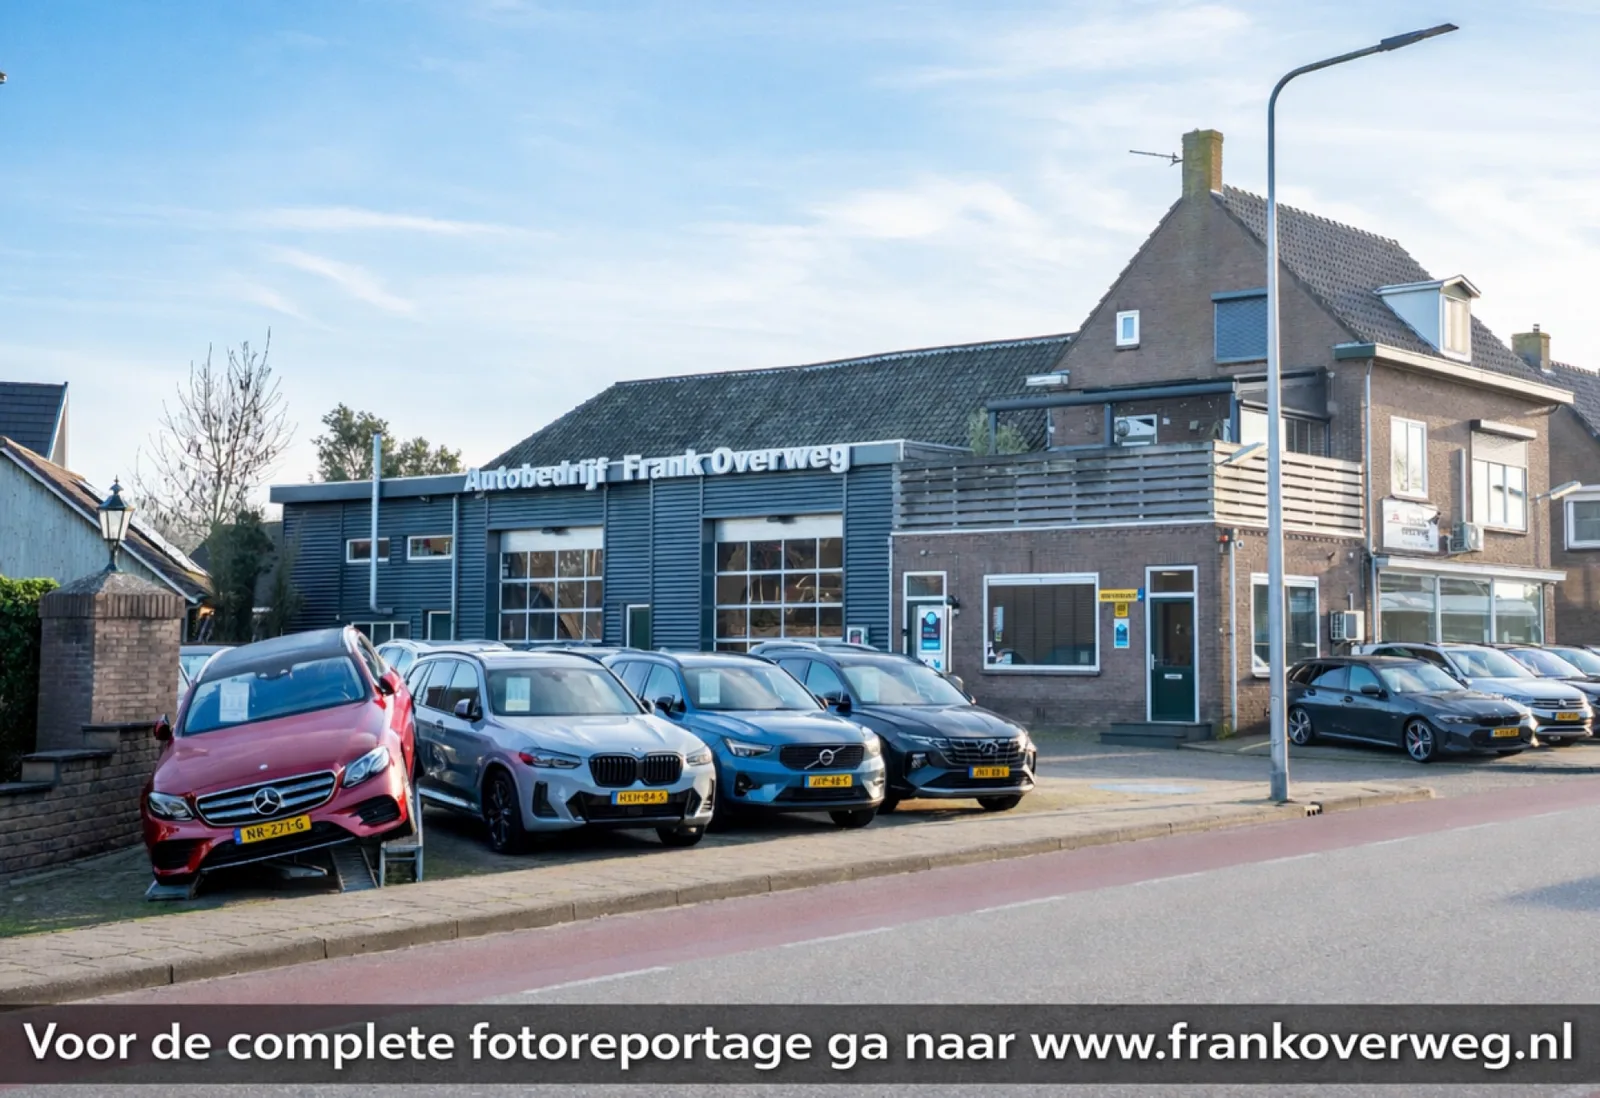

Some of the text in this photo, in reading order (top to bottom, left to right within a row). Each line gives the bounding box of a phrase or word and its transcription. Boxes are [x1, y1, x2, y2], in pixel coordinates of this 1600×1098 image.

[464, 444, 850, 491] Autobedrijf Frank Overweg
[246, 818, 304, 840] NR-271-G
